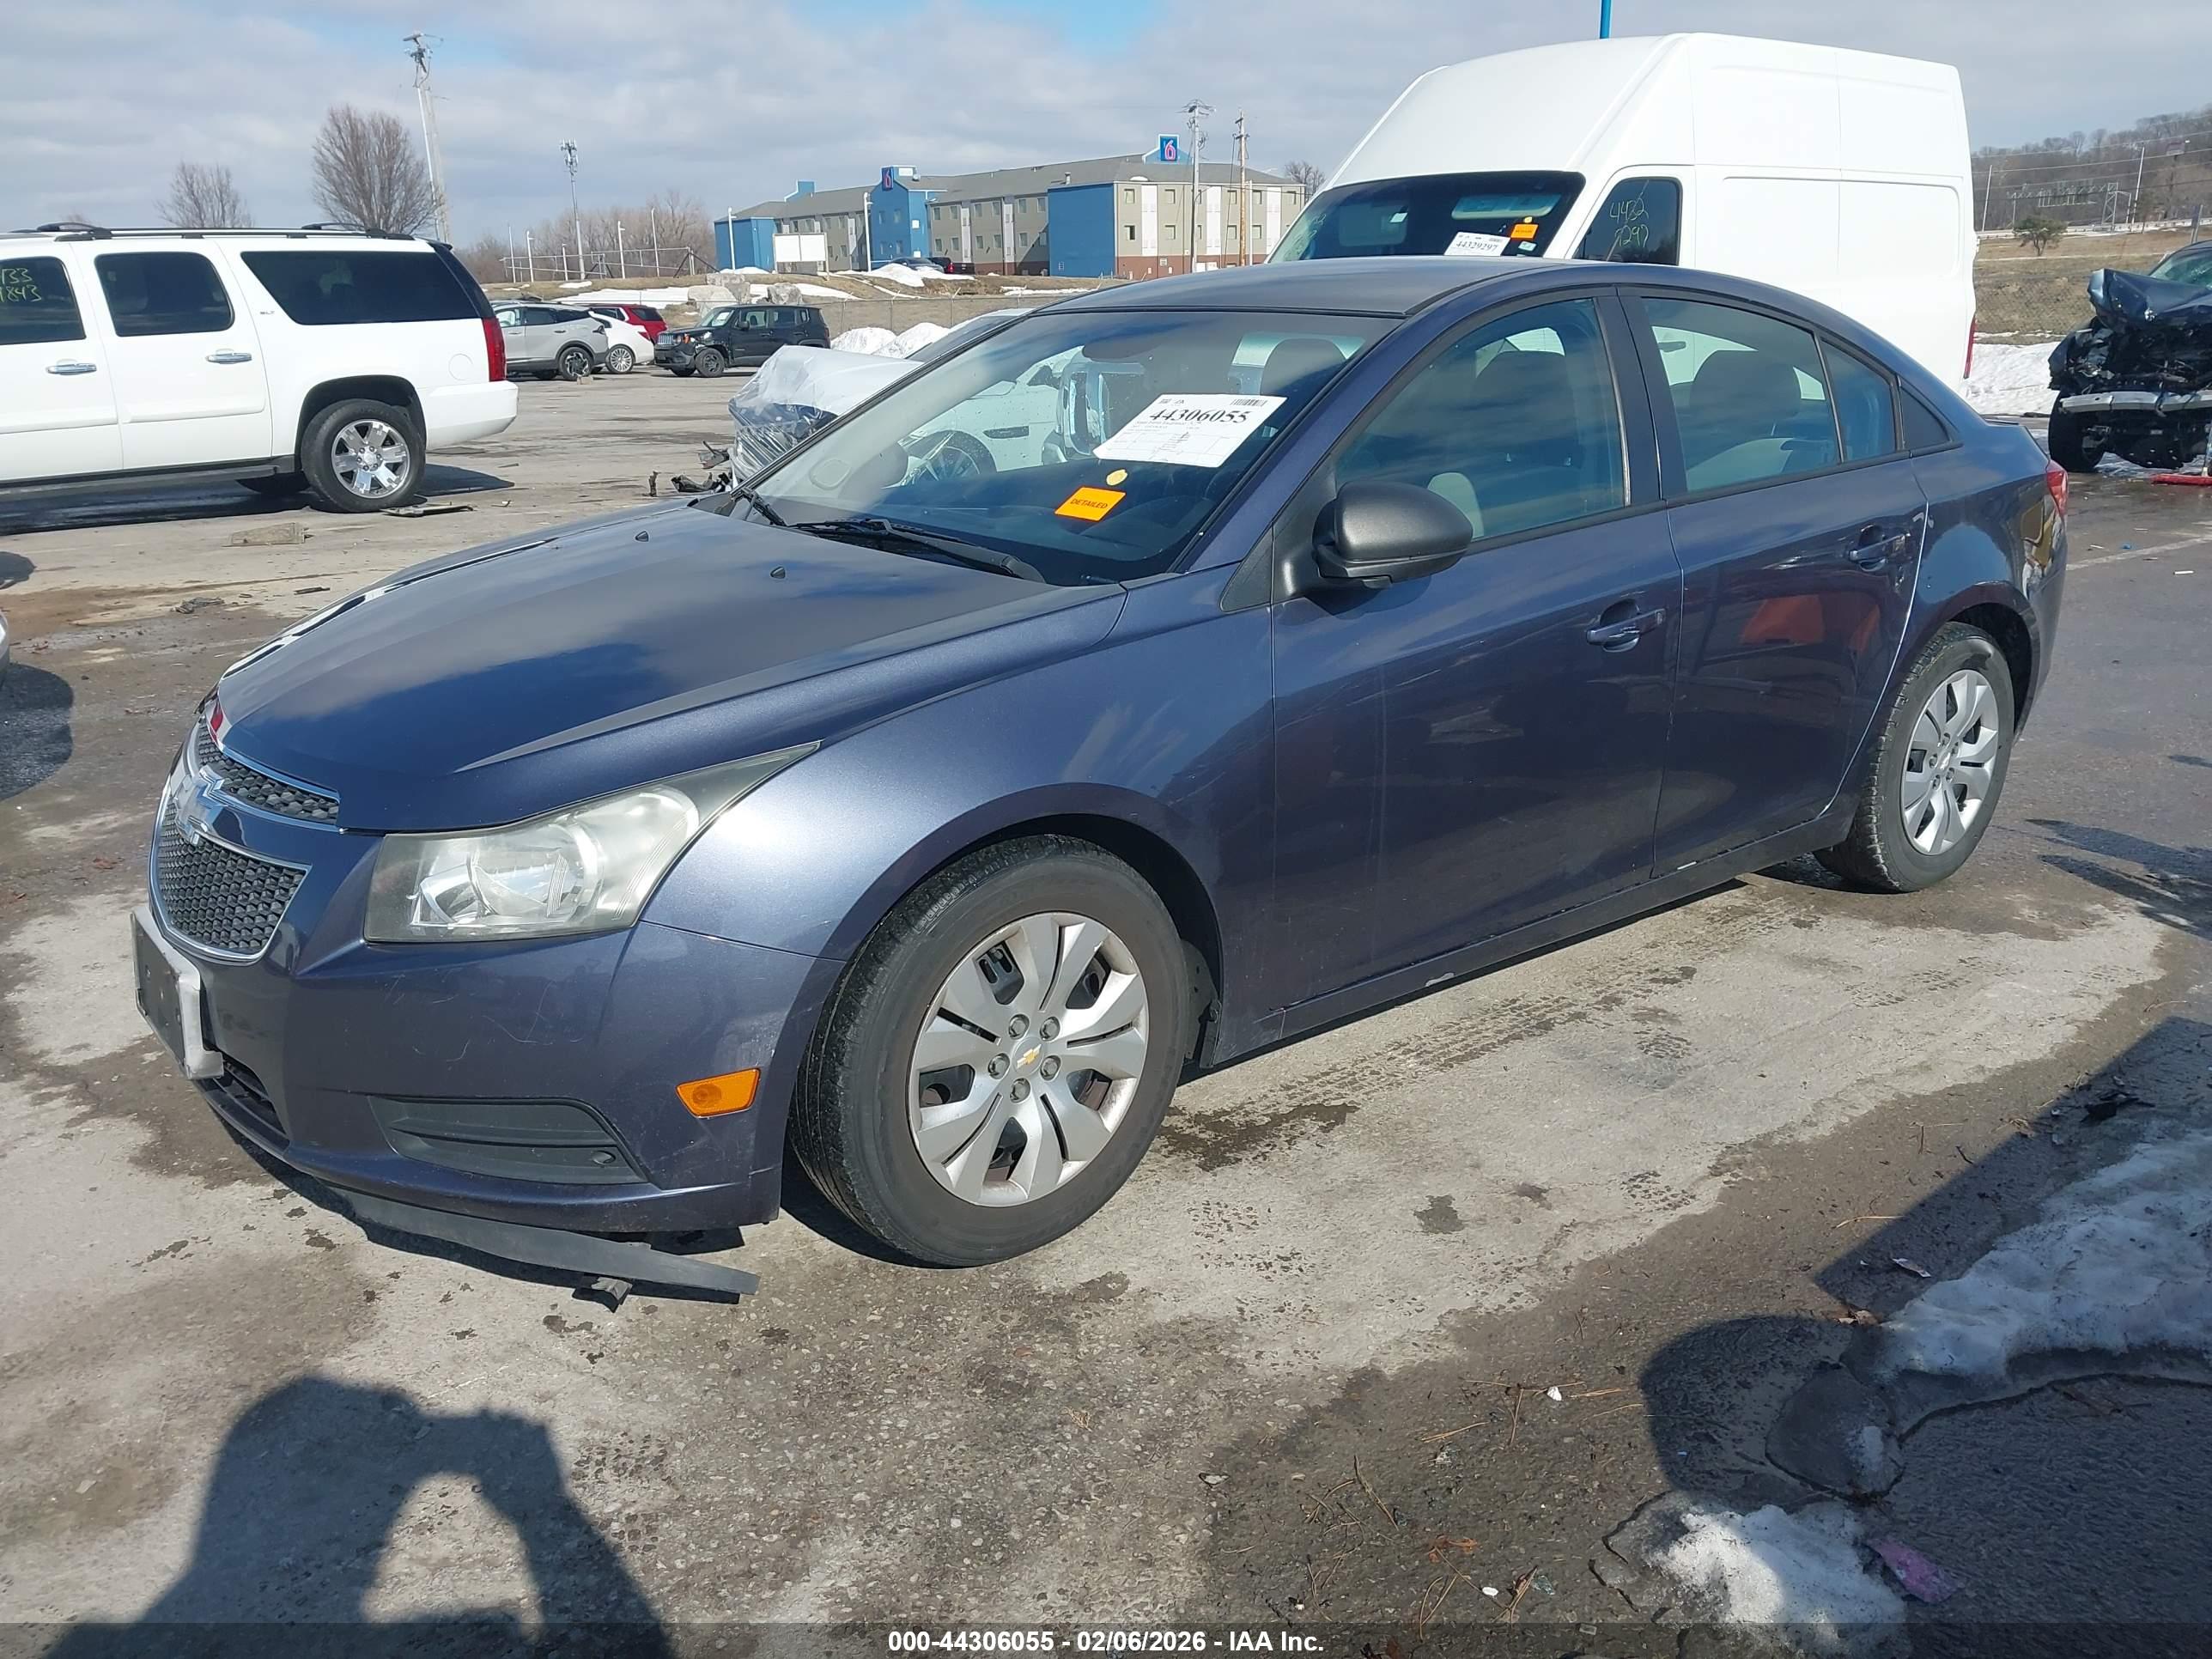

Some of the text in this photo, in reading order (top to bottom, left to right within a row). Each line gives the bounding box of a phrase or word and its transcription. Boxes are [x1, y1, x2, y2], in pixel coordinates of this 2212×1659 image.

[1164, 139, 1176, 161] 6
[1455, 240, 1498, 252] 44329297
[1149, 409, 1251, 424] 44306055
[1070, 498, 1108, 509] DETAILED
